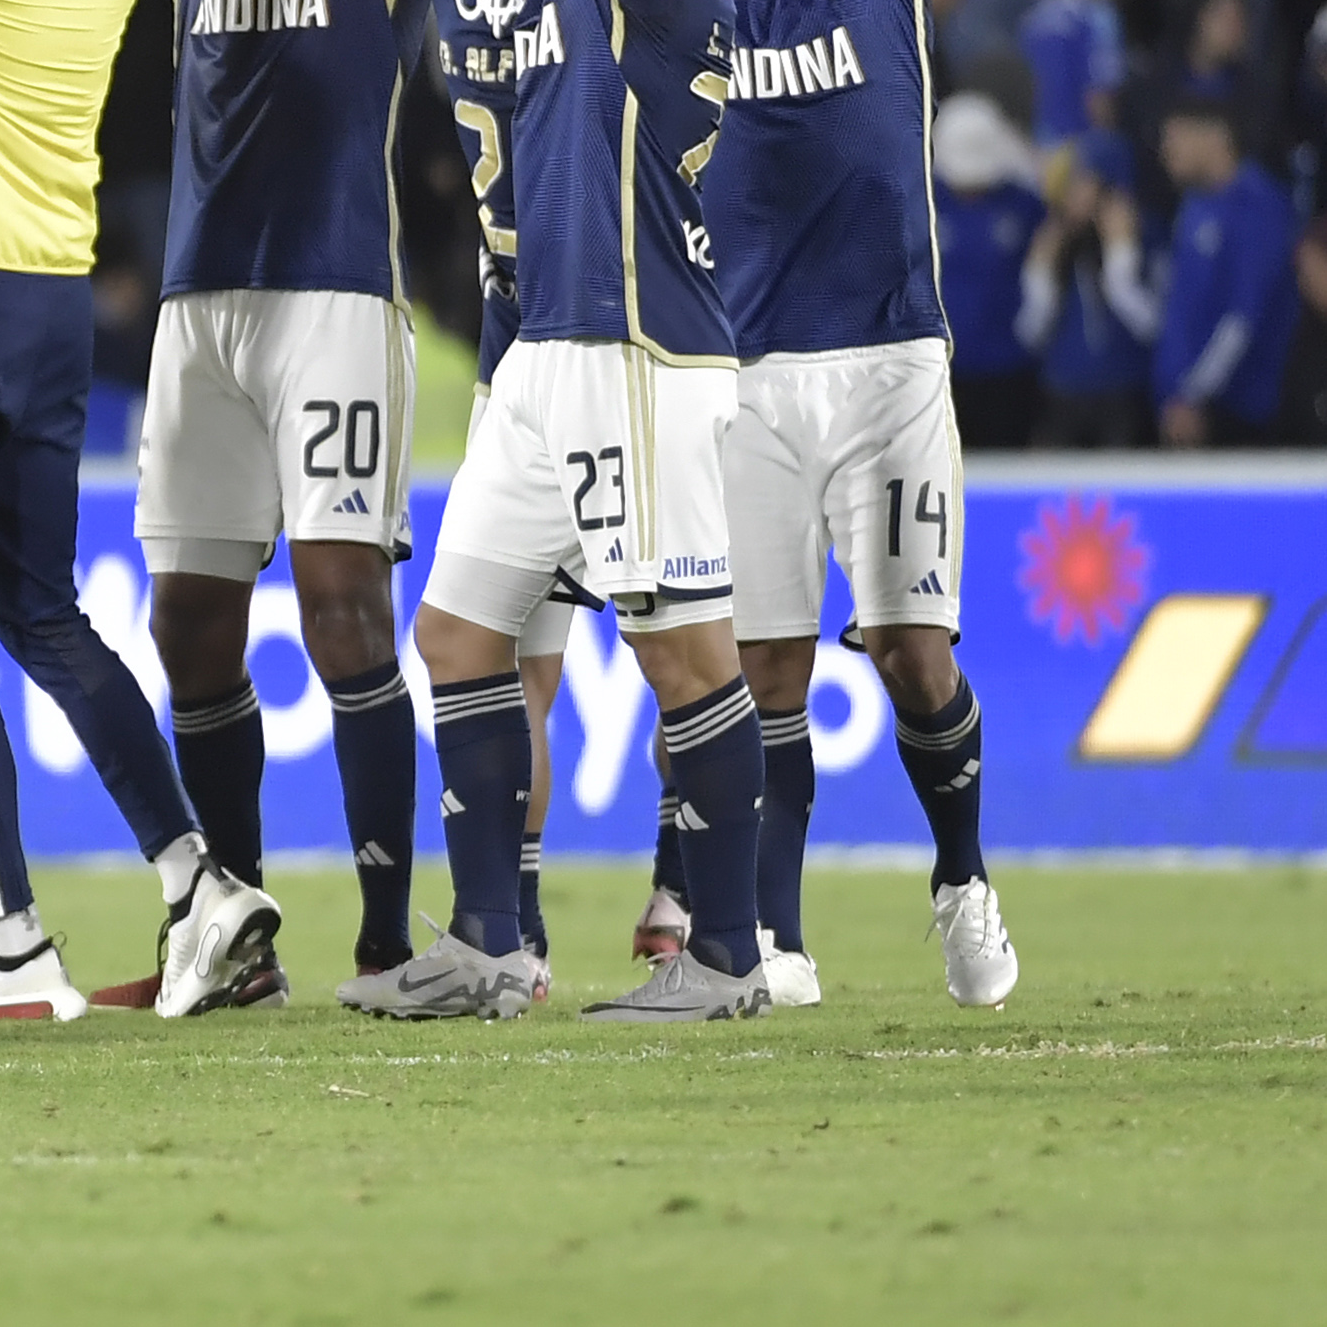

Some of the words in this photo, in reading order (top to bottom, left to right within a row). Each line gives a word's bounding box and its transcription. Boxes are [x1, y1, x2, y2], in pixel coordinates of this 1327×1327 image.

[302, 400, 380, 478] 20
[567, 445, 626, 532] 23
[886, 478, 947, 560] 14
[663, 556, 727, 580] Allianz
